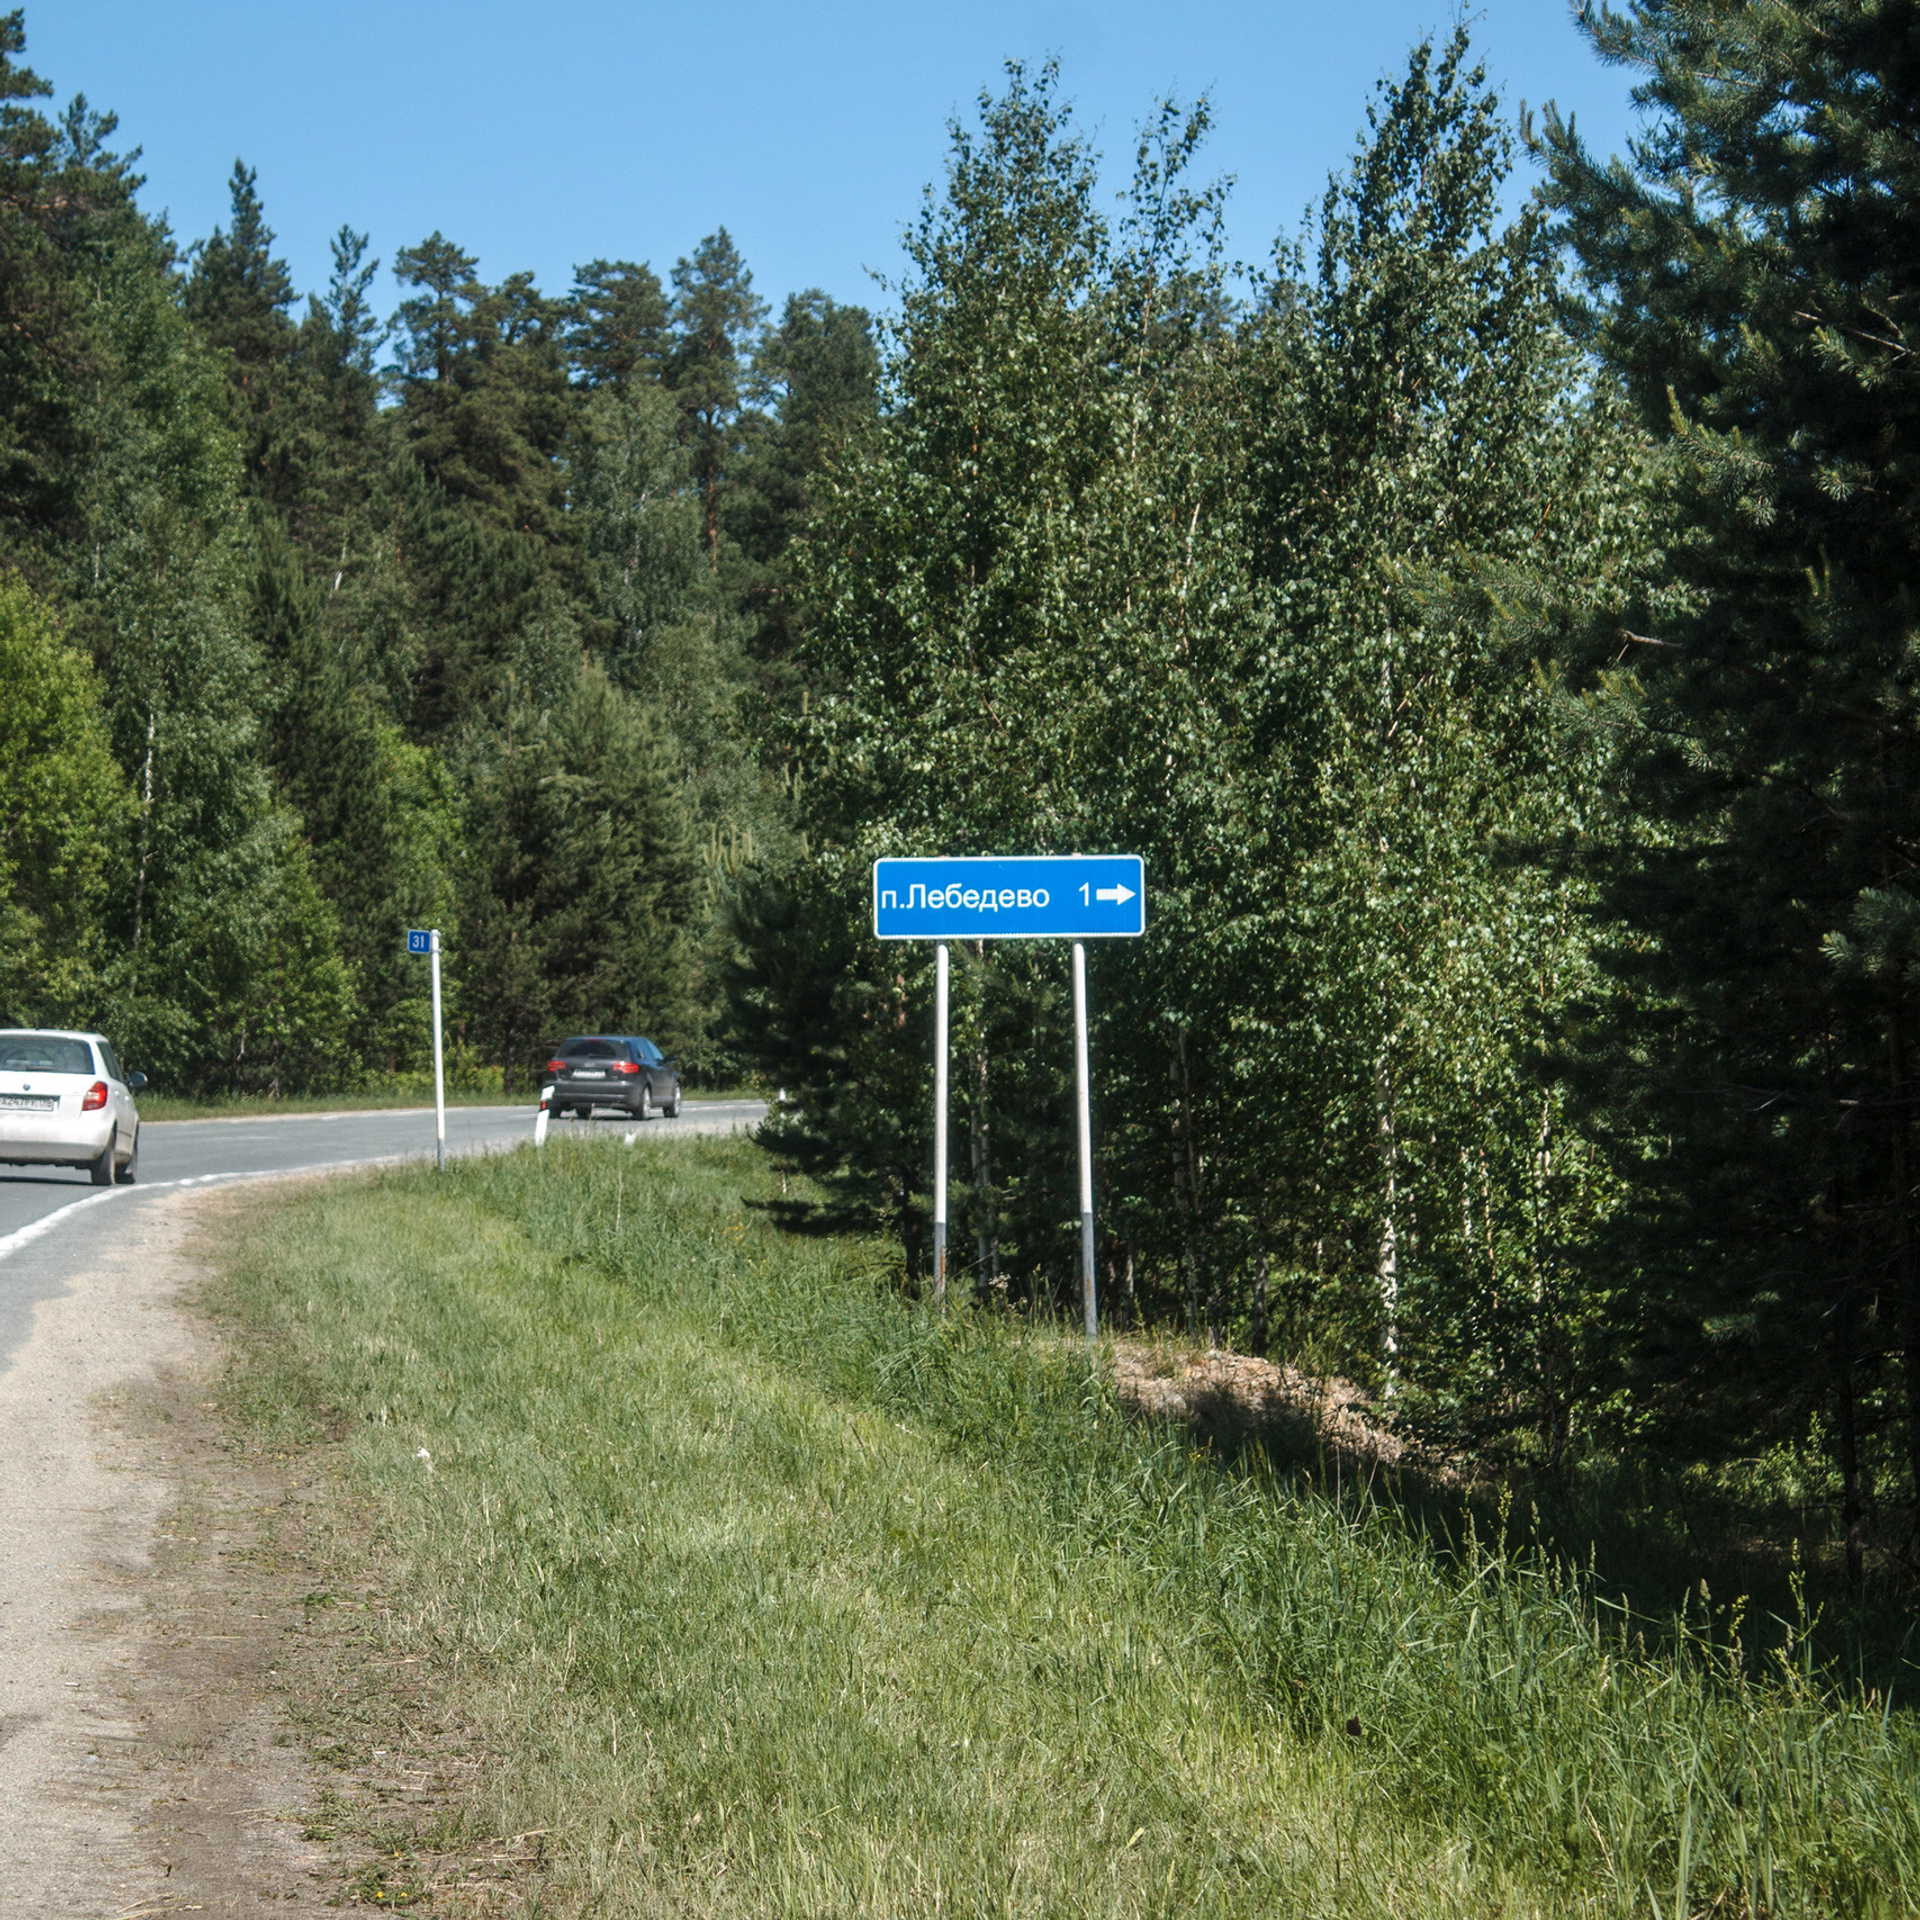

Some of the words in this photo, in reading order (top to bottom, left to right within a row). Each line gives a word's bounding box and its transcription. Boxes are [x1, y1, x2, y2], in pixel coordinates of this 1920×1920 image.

[881, 883, 1050, 912] п.Лебедево
[1078, 882, 1090, 906] 1
[412, 935, 424, 948] 31
